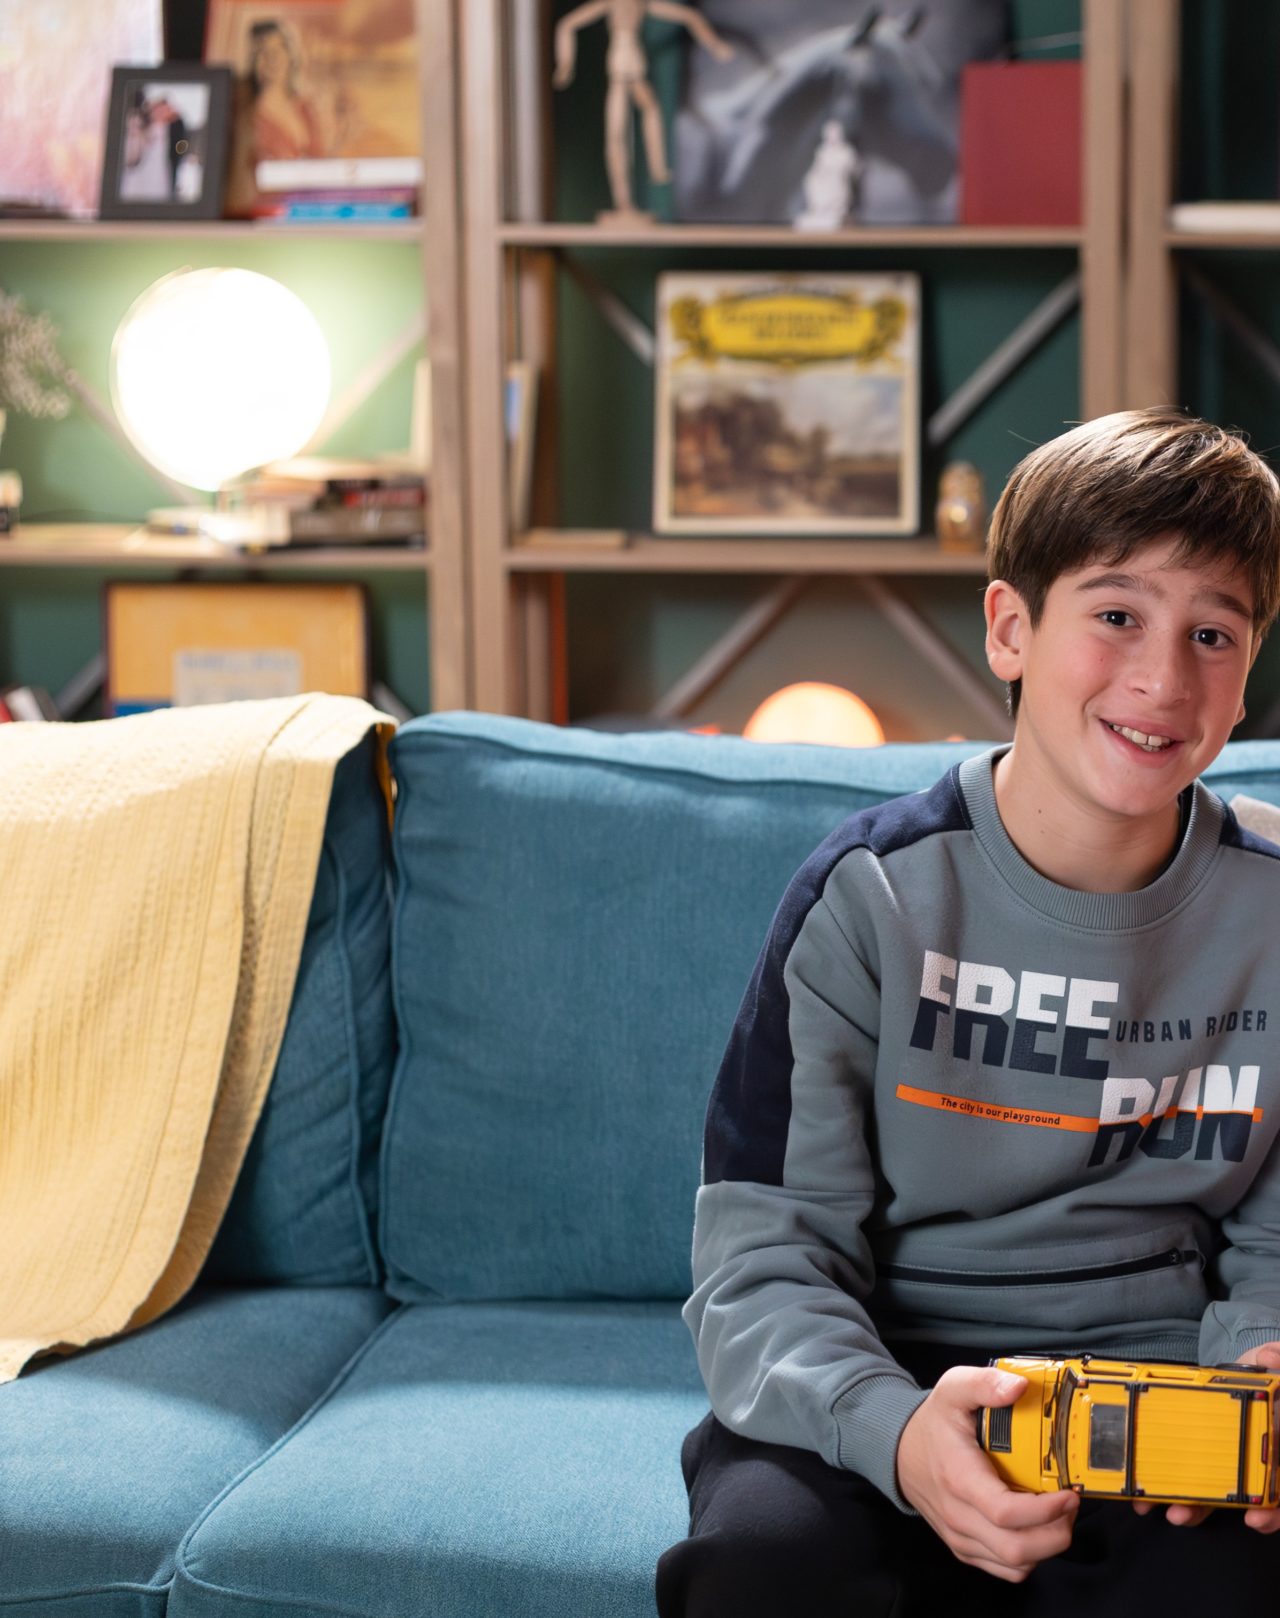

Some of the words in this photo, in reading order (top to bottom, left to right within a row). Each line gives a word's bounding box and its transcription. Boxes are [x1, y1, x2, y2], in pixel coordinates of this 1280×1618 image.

[909, 949, 1120, 1081] FREE
[1115, 1018, 1192, 1043] URBAN
[1205, 1010, 1268, 1038] RIDER
[941, 1097, 958, 1108] The
[959, 1101, 975, 1114] city
[976, 1104, 984, 1114] is
[986, 1107, 1001, 1117] our
[1003, 1110, 1061, 1125] playground
[1087, 1064, 1261, 1168] RUN
